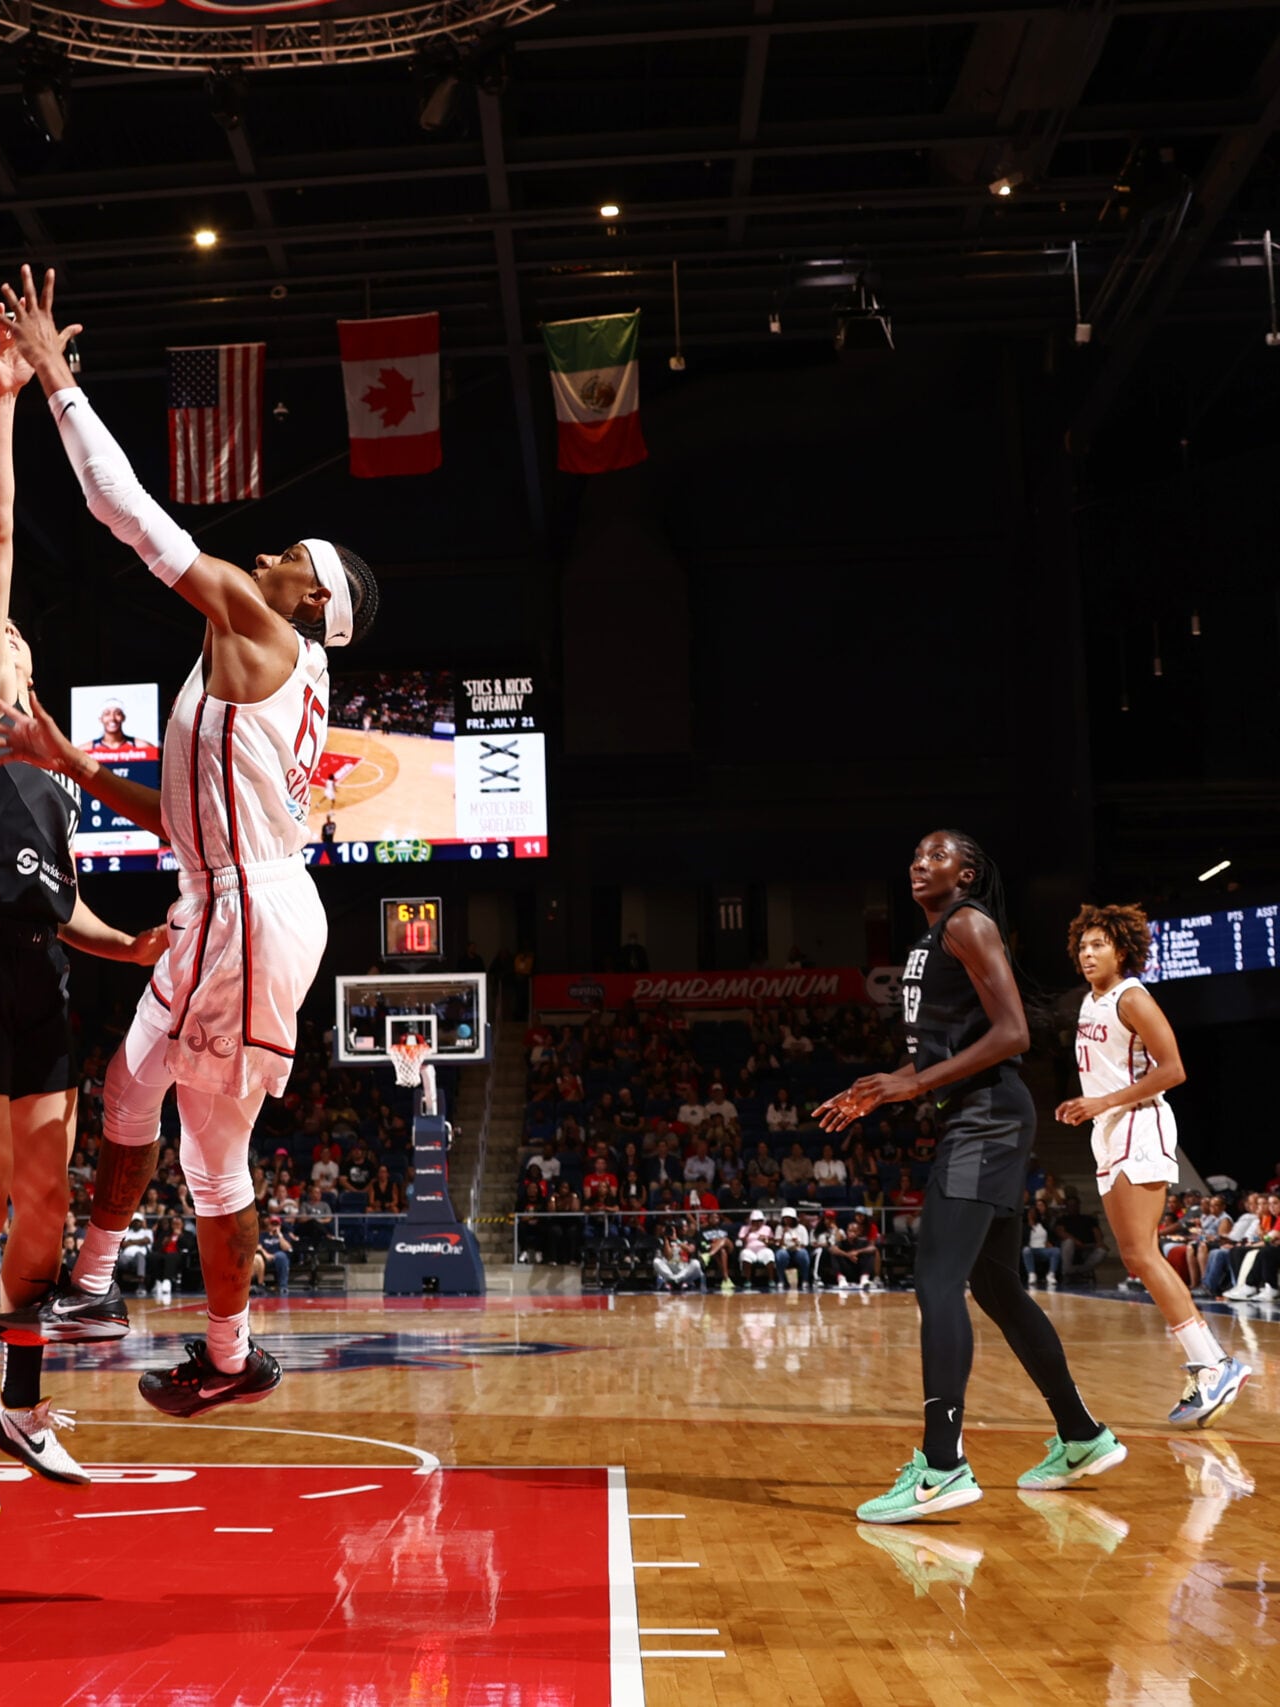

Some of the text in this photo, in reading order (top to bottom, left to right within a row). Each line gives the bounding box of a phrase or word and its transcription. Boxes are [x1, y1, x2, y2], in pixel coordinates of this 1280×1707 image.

[494, 679, 502, 695] &
[505, 678, 533, 694] KICKS
[471, 695, 524, 712] GIVEAWAY
[522, 716, 535, 727] 21
[294, 684, 326, 780] 15
[91, 799, 101, 811] 0
[92, 815, 102, 827] 0
[82, 858, 93, 872] 3
[109, 856, 121, 871] 2
[337, 842, 369, 863] 10
[470, 844, 482, 860] 0
[497, 843, 509, 858] 3
[523, 841, 541, 855] 11
[398, 903, 435, 922] 6:17
[720, 904, 743, 929] 111
[1181, 915, 1212, 928] PLAYER
[1227, 911, 1244, 922] PTS
[1256, 905, 1278, 918] ASST
[406, 921, 429, 951] 10
[1162, 933, 1169, 941] 4
[1163, 942, 1169, 950] 7
[1171, 948, 1197, 959] Cloud
[633, 975, 839, 999] PANDAMONIUM
[902, 985, 921, 1023] 13
